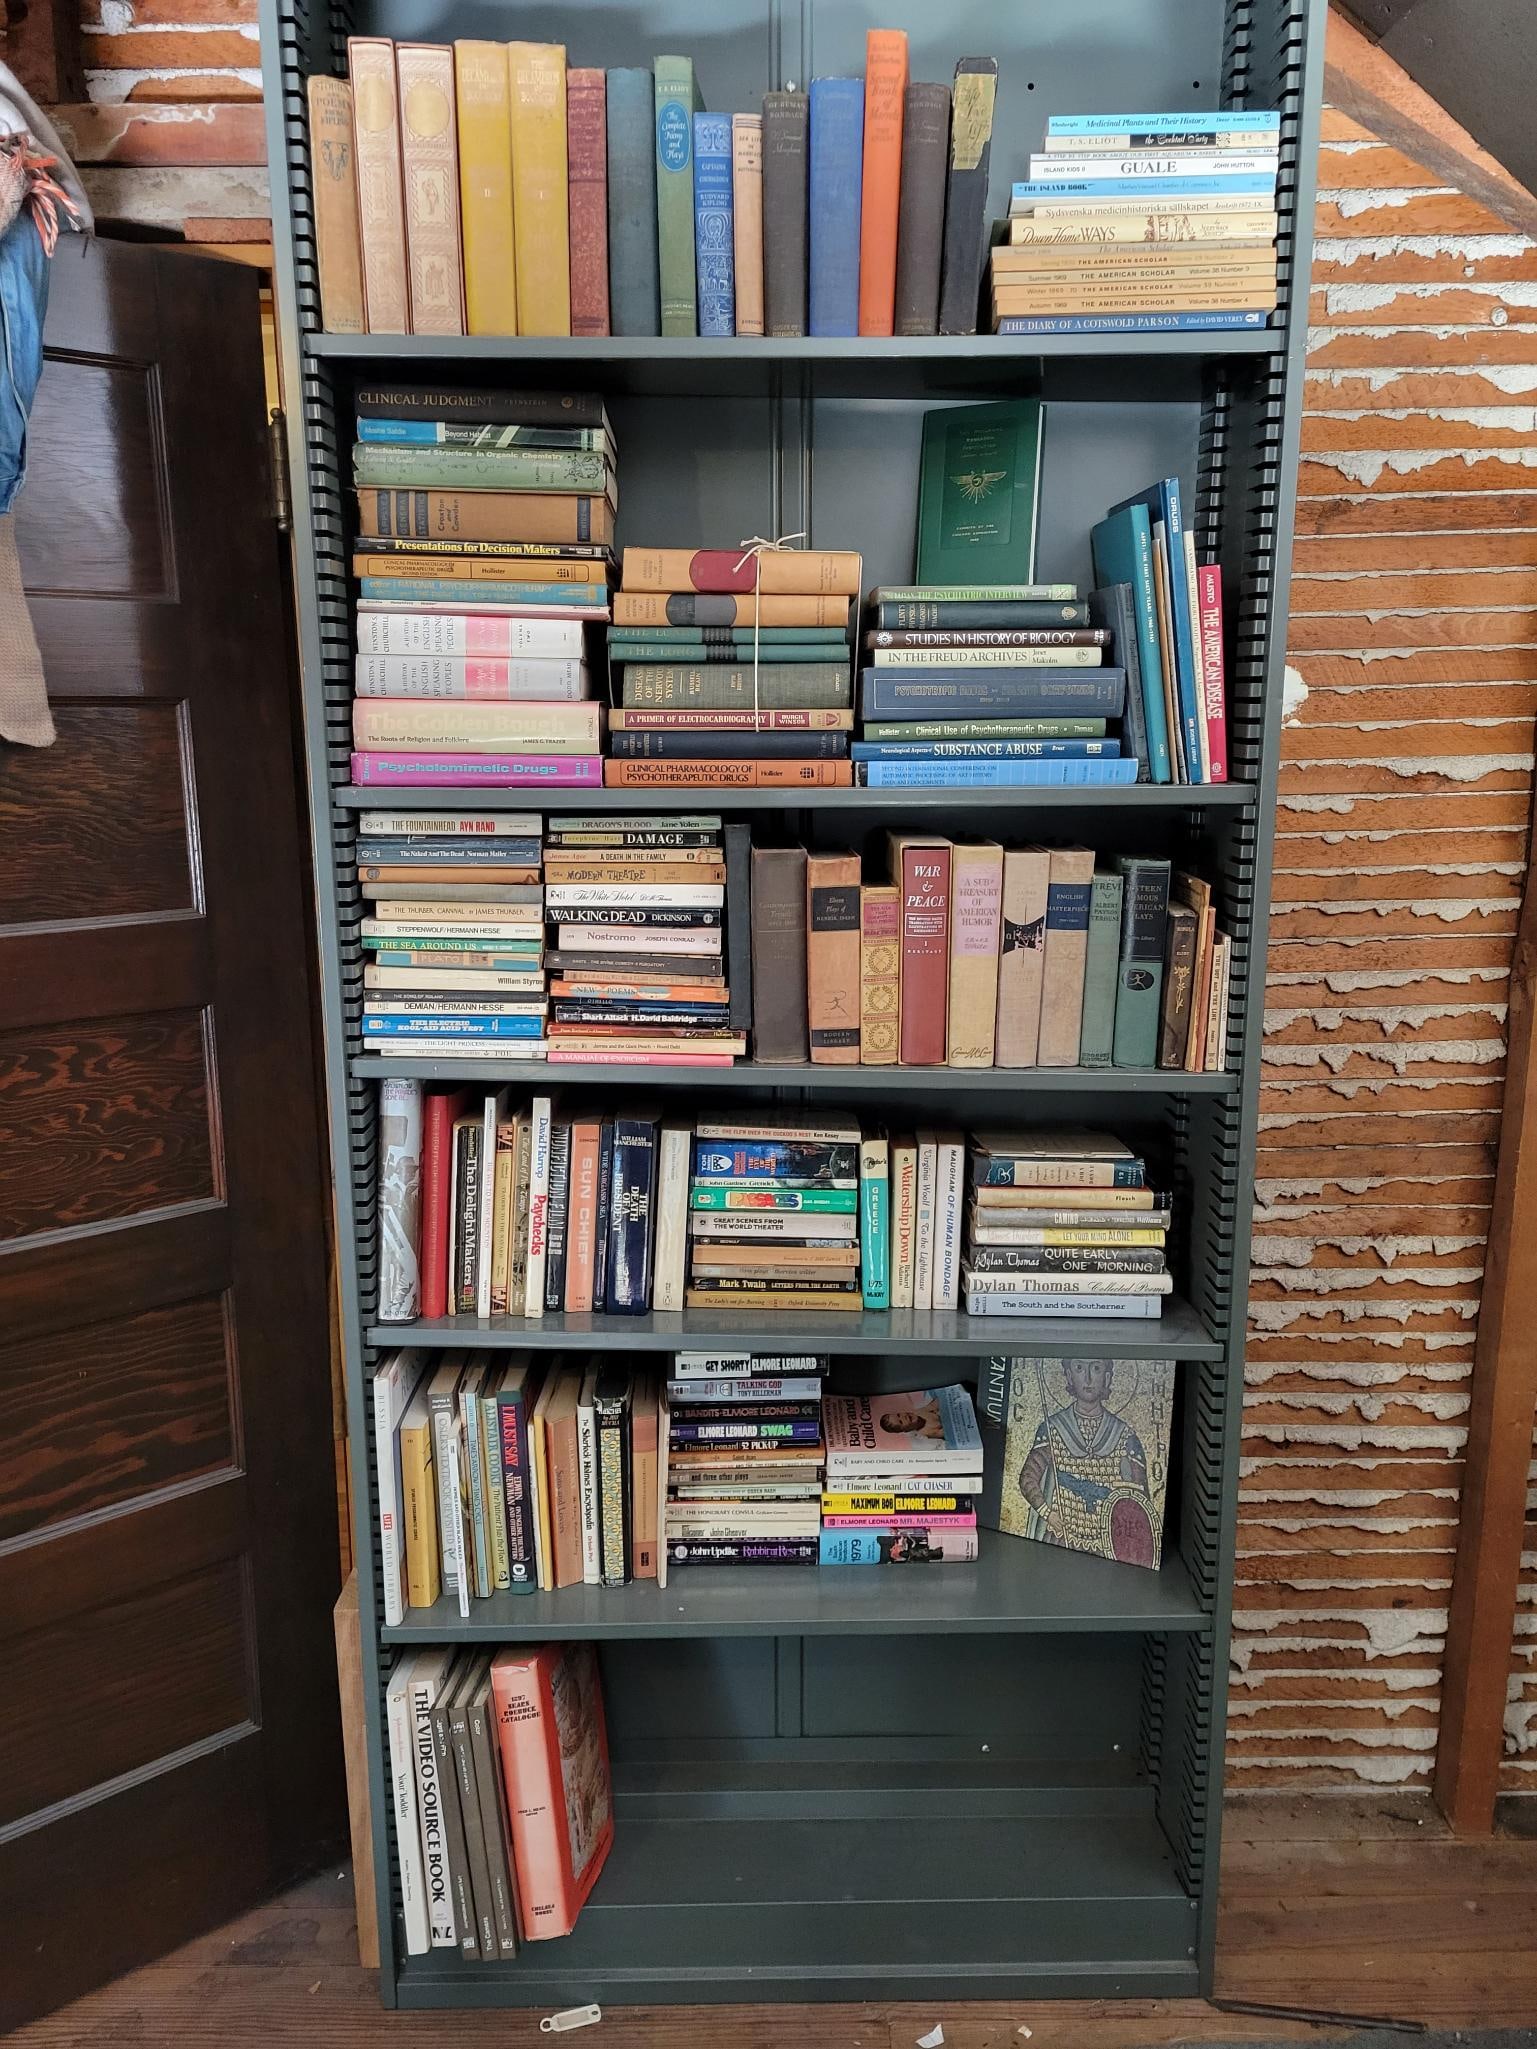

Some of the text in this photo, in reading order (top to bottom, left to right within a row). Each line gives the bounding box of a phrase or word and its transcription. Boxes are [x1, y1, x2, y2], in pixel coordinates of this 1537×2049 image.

[1086, 120, 1121, 128] Medicinal
[1144, 118, 1158, 126] and
[1180, 117, 1207, 125] History
[1120, 161, 1178, 174] GUALE
[1046, 207, 1092, 218] Sydsvenska
[1094, 203, 1167, 216] medicinhistoriska
[1023, 226, 1116, 244] Down Home WAYS
[1005, 316, 1179, 331] THE DIARY OF A COTSWOLD PARSON
[358, 393, 493, 407] CLINICAL JUDGMENT
[1170, 496, 1179, 533] DRUGS
[395, 540, 561, 555] Presentations for Decision Makers
[905, 632, 1076, 645] STUDIES IN HISTORY OF BIOLOGY
[1204, 574, 1222, 720] MUSTO THE AMERICAN DISEASE
[888, 652, 1027, 662] IN THE FREUD ARCHIVES
[637, 715, 664, 723] PRIMER
[916, 724, 1059, 736] Clinical Use of Psychotherapeutic Drugs
[934, 744, 1042, 756] SUBSTANCE ABUSE
[512, 763, 558, 775] Drugs
[666, 765, 739, 773] PHARMACOLOGY
[626, 774, 749, 782] PSYCHOTHERAPEUTIC DRUGS
[392, 821, 496, 832] THE FOUNTAINHEAD AYN RAND
[627, 834, 684, 844] DAMAGE
[914, 866, 941, 878] WAR
[922, 881, 933, 893] &
[906, 895, 946, 908] PEACE
[550, 910, 692, 922] WALKING DEAD DICKINSON
[587, 932, 636, 942] Nostromo
[420, 942, 461, 950] AROUND
[537, 1118, 548, 1178] David Harrop
[612, 1173, 624, 1232] PRESIDENT
[630, 1186, 640, 1222] DEATH
[579, 1158, 592, 1265] SUN CHIEF
[899, 1164, 913, 1263] Watership Down
[463, 1157, 477, 1286] The Delight Makers
[531, 1194, 547, 1255] Paychecks
[943, 1150, 957, 1298] MAUGHAM OF HUMAN BONDAGE
[1083, 1249, 1119, 1259] EARLY
[719, 1280, 766, 1288] Mark Twain
[973, 1280, 1080, 1294] Dylan Thomas
[1077, 1302, 1125, 1310] Southerner
[706, 1358, 817, 1372] GET SHORTY ELMORE LEONARD
[698, 1425, 793, 1438] ELMORE LEONARD SWAG
[847, 1422, 860, 1446] Baby
[861, 1422, 876, 1448] Child
[502, 1412, 518, 1467] MUST SAY
[582, 1427, 594, 1531] Sherlock Holmes Encyclopedia
[851, 1498, 956, 1510] MAXIMUM BOB ELMORE LEONARD
[851, 1539, 861, 1561] 1979
[503, 1706, 537, 1717] ROEBUCK
[507, 1701, 530, 1709] SEARS
[500, 1712, 541, 1723] CATALOGUE
[414, 1689, 446, 1903] THE VIDEO SOURCE BOOK
